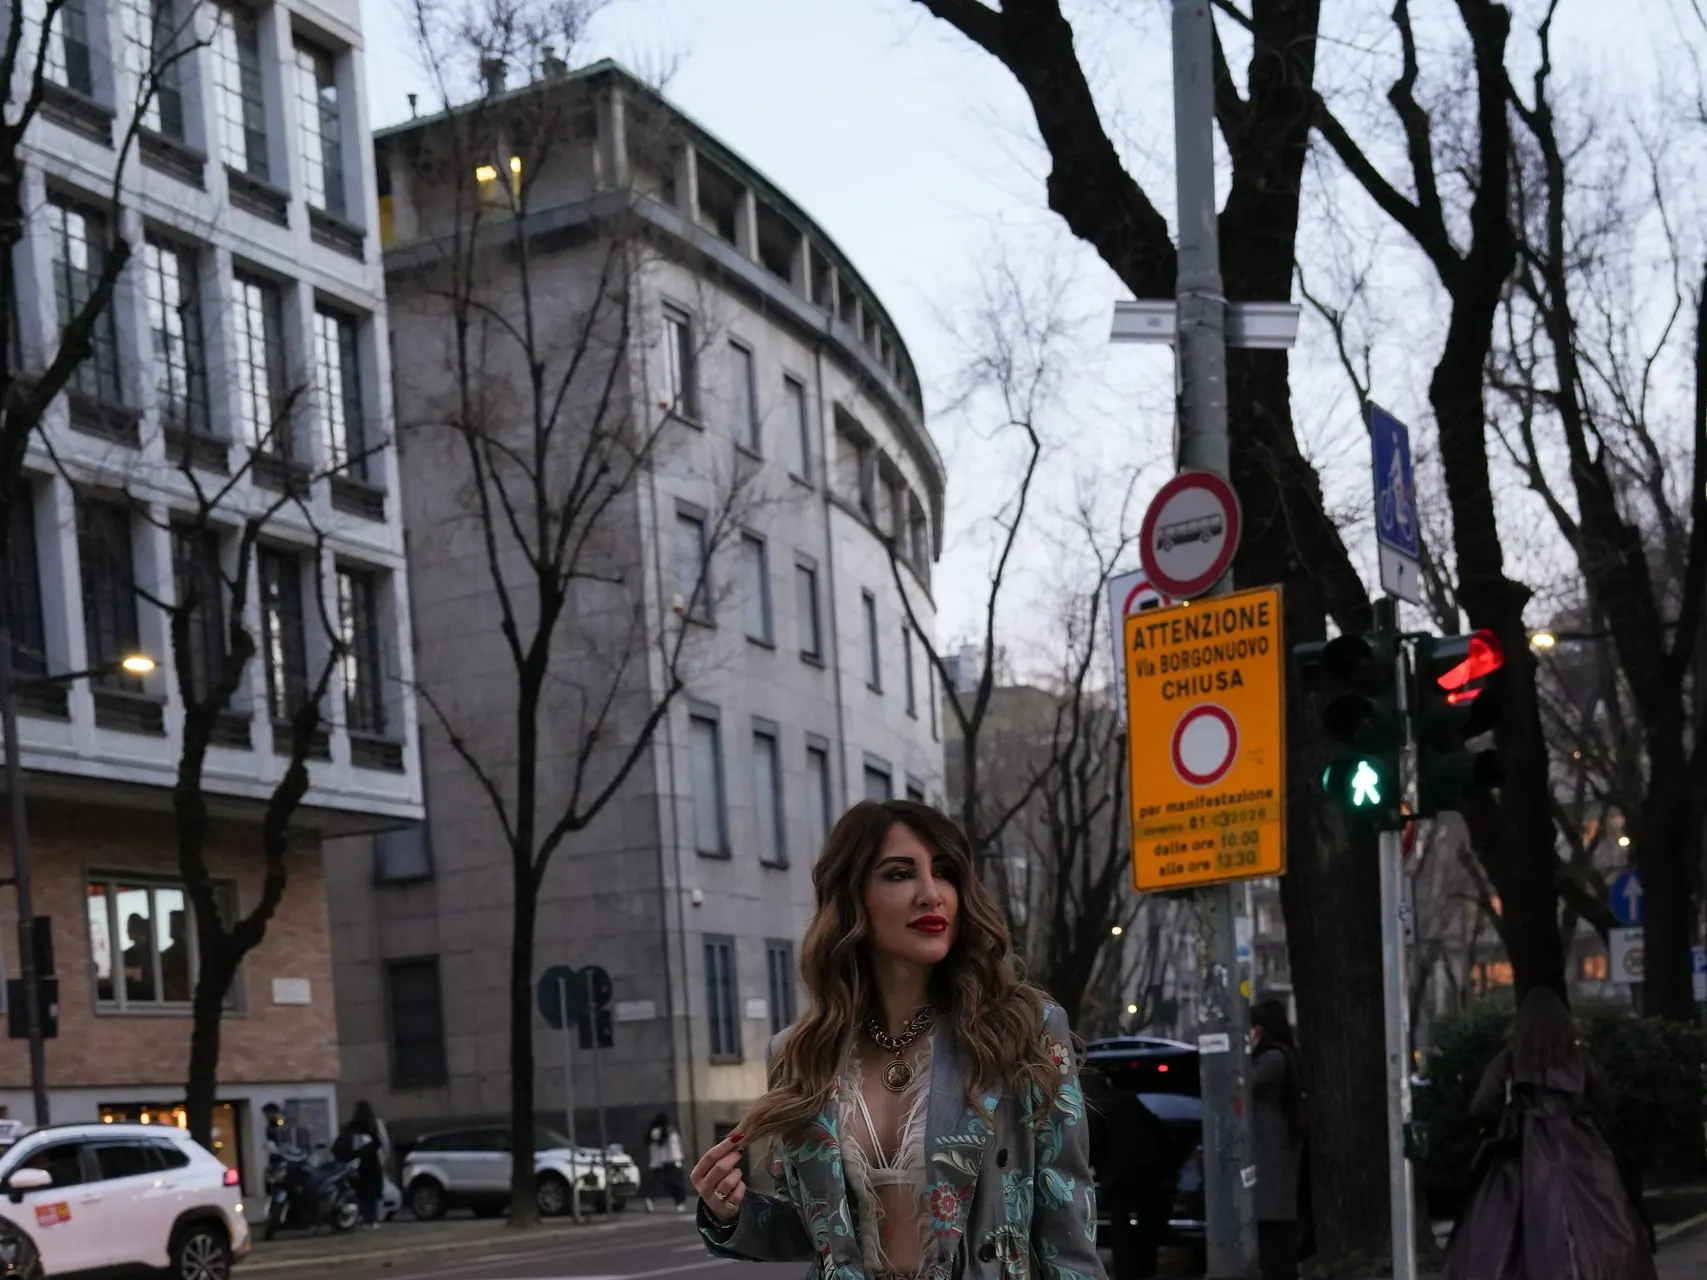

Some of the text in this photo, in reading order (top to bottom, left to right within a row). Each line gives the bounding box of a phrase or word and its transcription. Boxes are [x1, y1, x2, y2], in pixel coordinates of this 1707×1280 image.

[1134, 602, 1270, 652] ATTENZIONE
[1136, 636, 1269, 678] Via BORGONUOVO
[1162, 668, 1244, 701] CHIUSA
[1139, 788, 1273, 820] per manifestazione
[1153, 840, 1187, 857] dalle
[1192, 838, 1215, 851] ore
[1159, 862, 1184, 876] alle
[1188, 860, 1211, 873] ore
